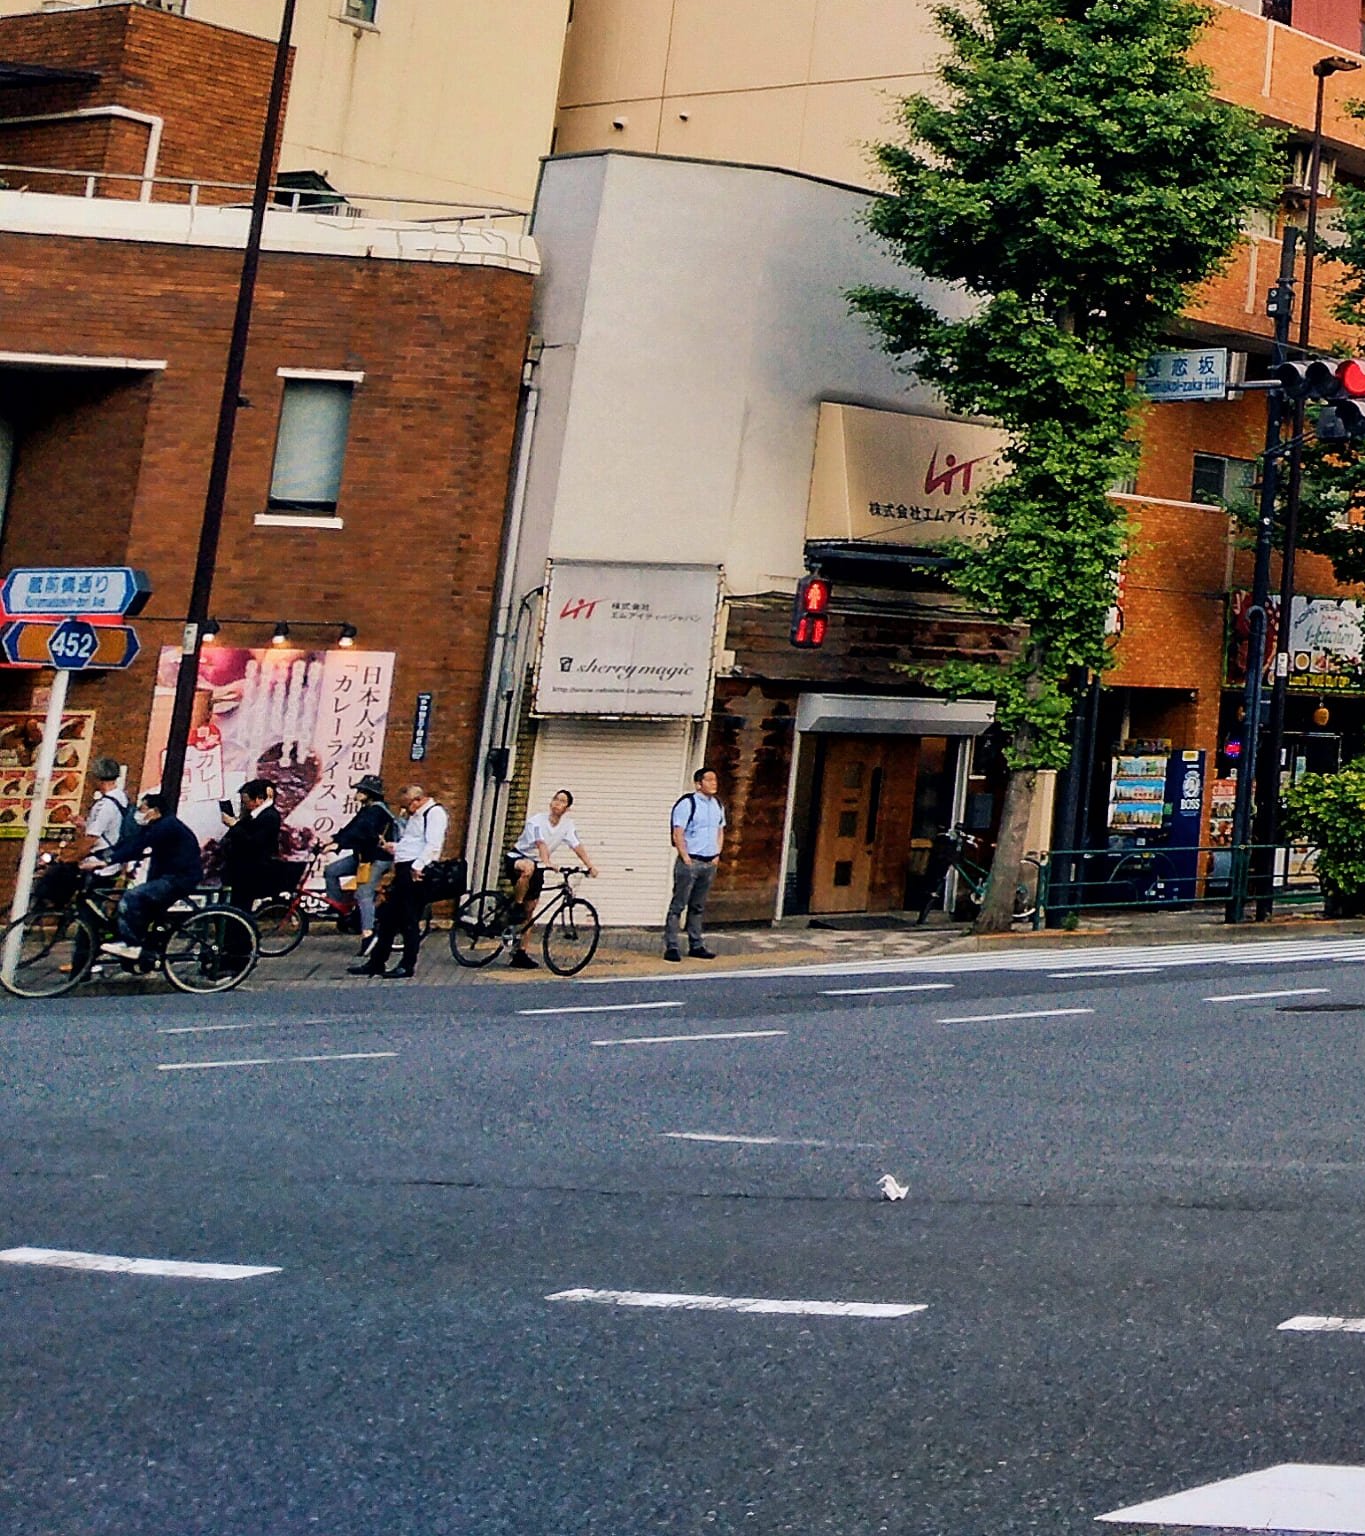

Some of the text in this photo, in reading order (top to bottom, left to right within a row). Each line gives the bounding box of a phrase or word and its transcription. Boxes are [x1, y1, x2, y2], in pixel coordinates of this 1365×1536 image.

[51, 632, 93, 658] 452
[638, 663, 695, 682] magic
[1180, 798, 1200, 810] BOSS
